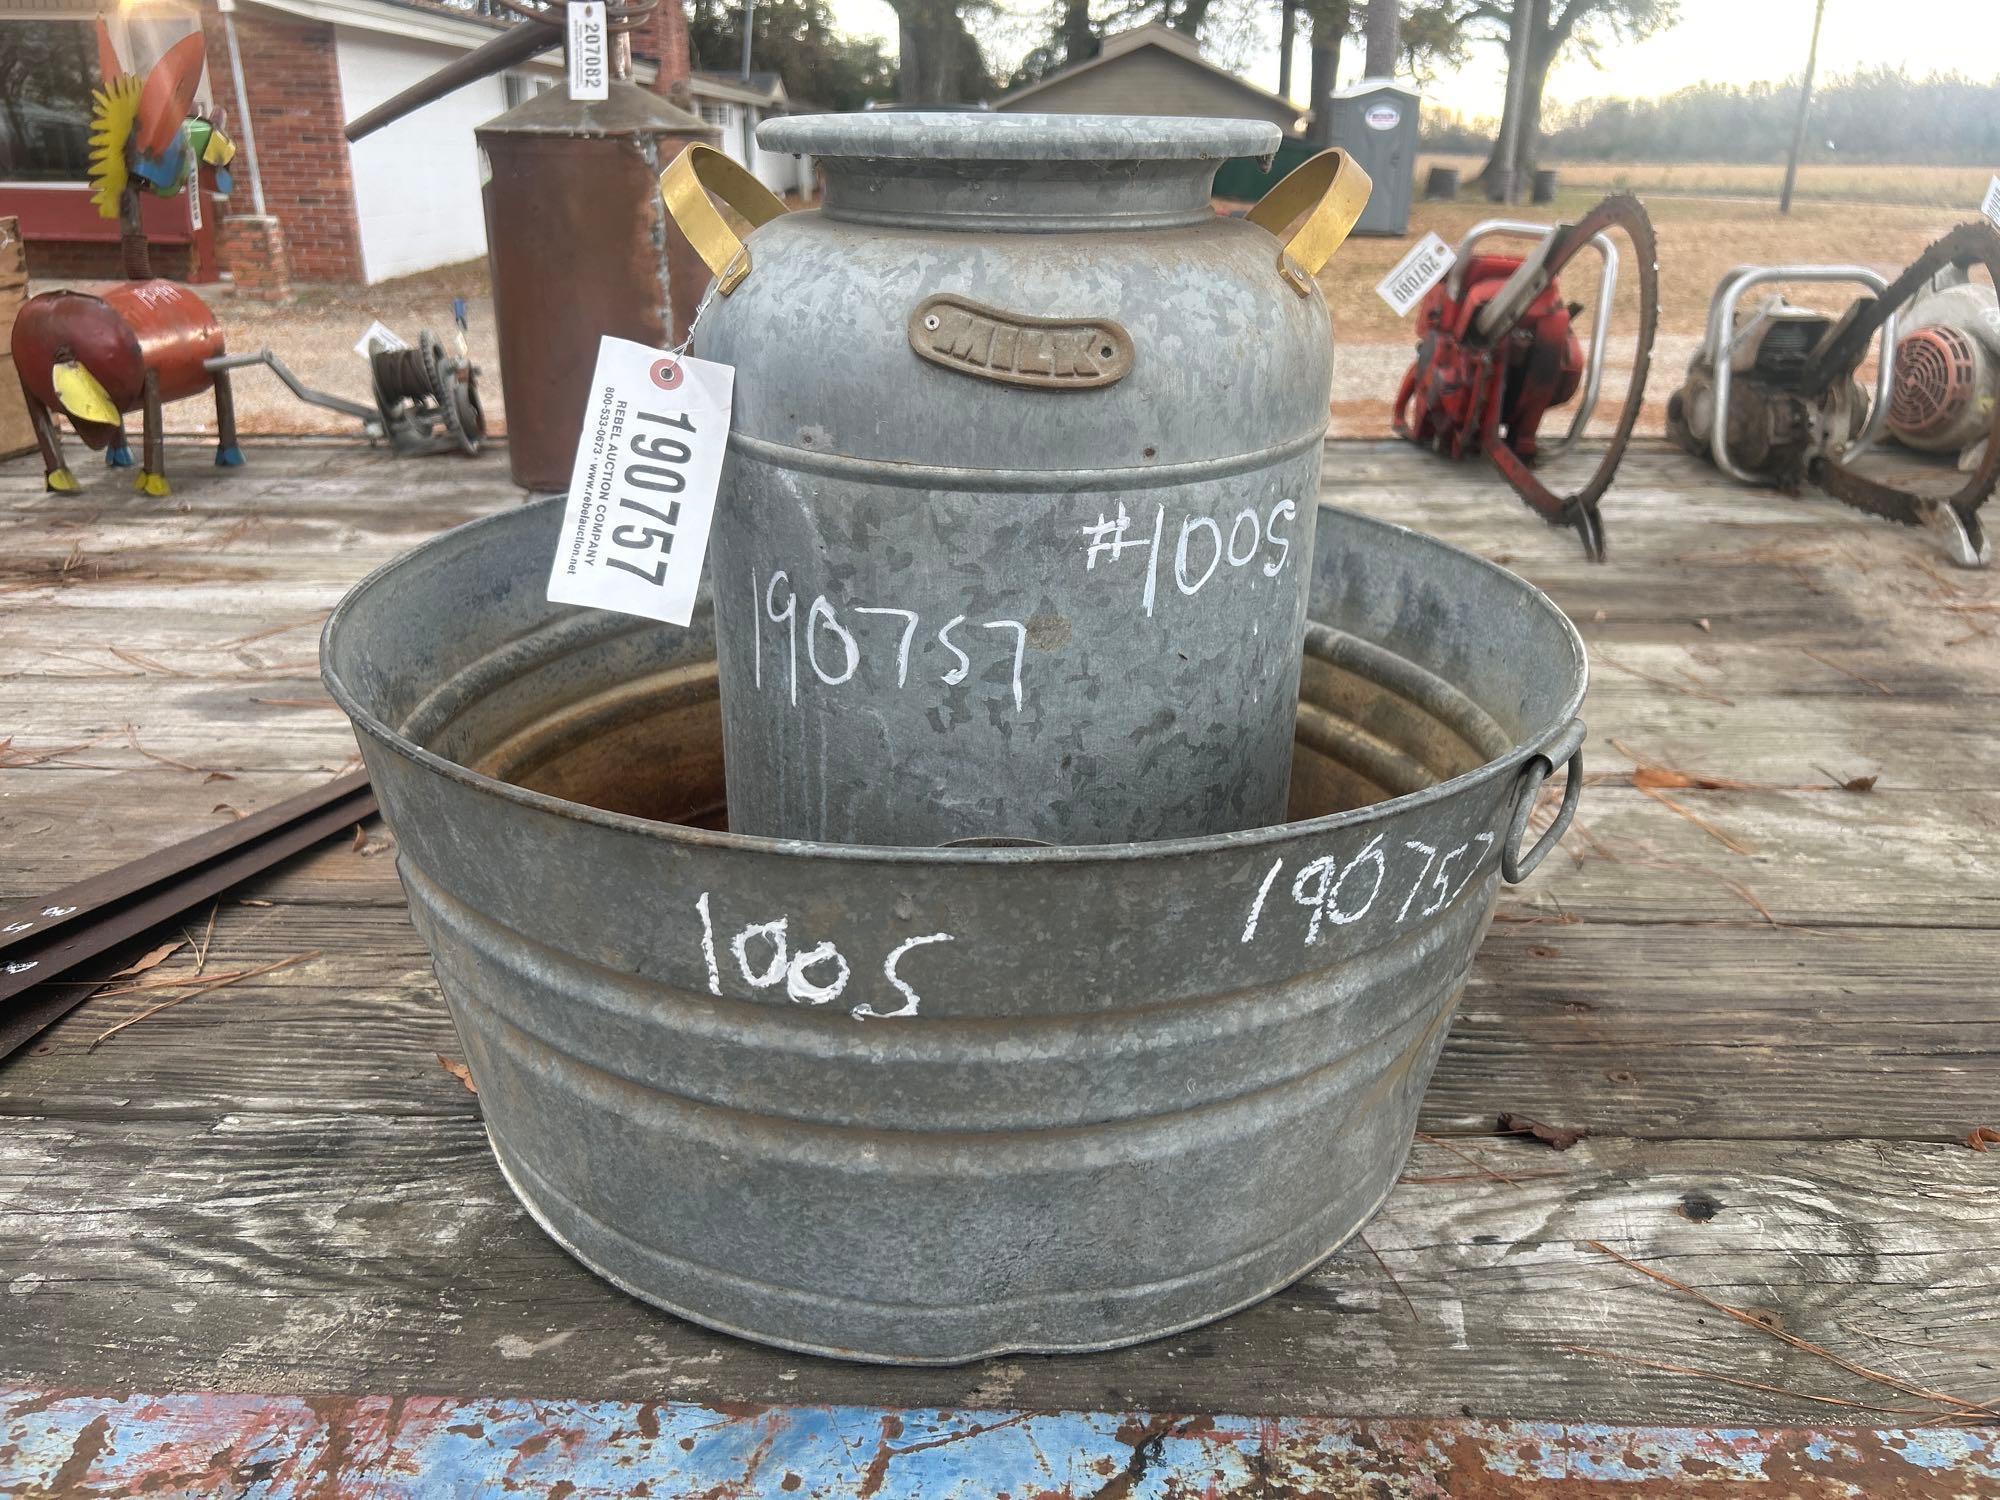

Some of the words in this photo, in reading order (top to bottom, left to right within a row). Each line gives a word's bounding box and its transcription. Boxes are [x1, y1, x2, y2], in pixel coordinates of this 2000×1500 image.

[584, 23, 601, 88] 207082
[931, 311, 1101, 378] MILK
[594, 386, 615, 456] 800-533-0673
[611, 400, 628, 441] REBEL
[600, 443, 619, 499] AUCTION
[606, 410, 697, 586] 190757
[566, 463, 598, 576] www.rebelauction.net
[583, 504, 607, 566] COMPANY
[750, 569, 1027, 713] 190757
[1241, 832, 1496, 947] 190757
